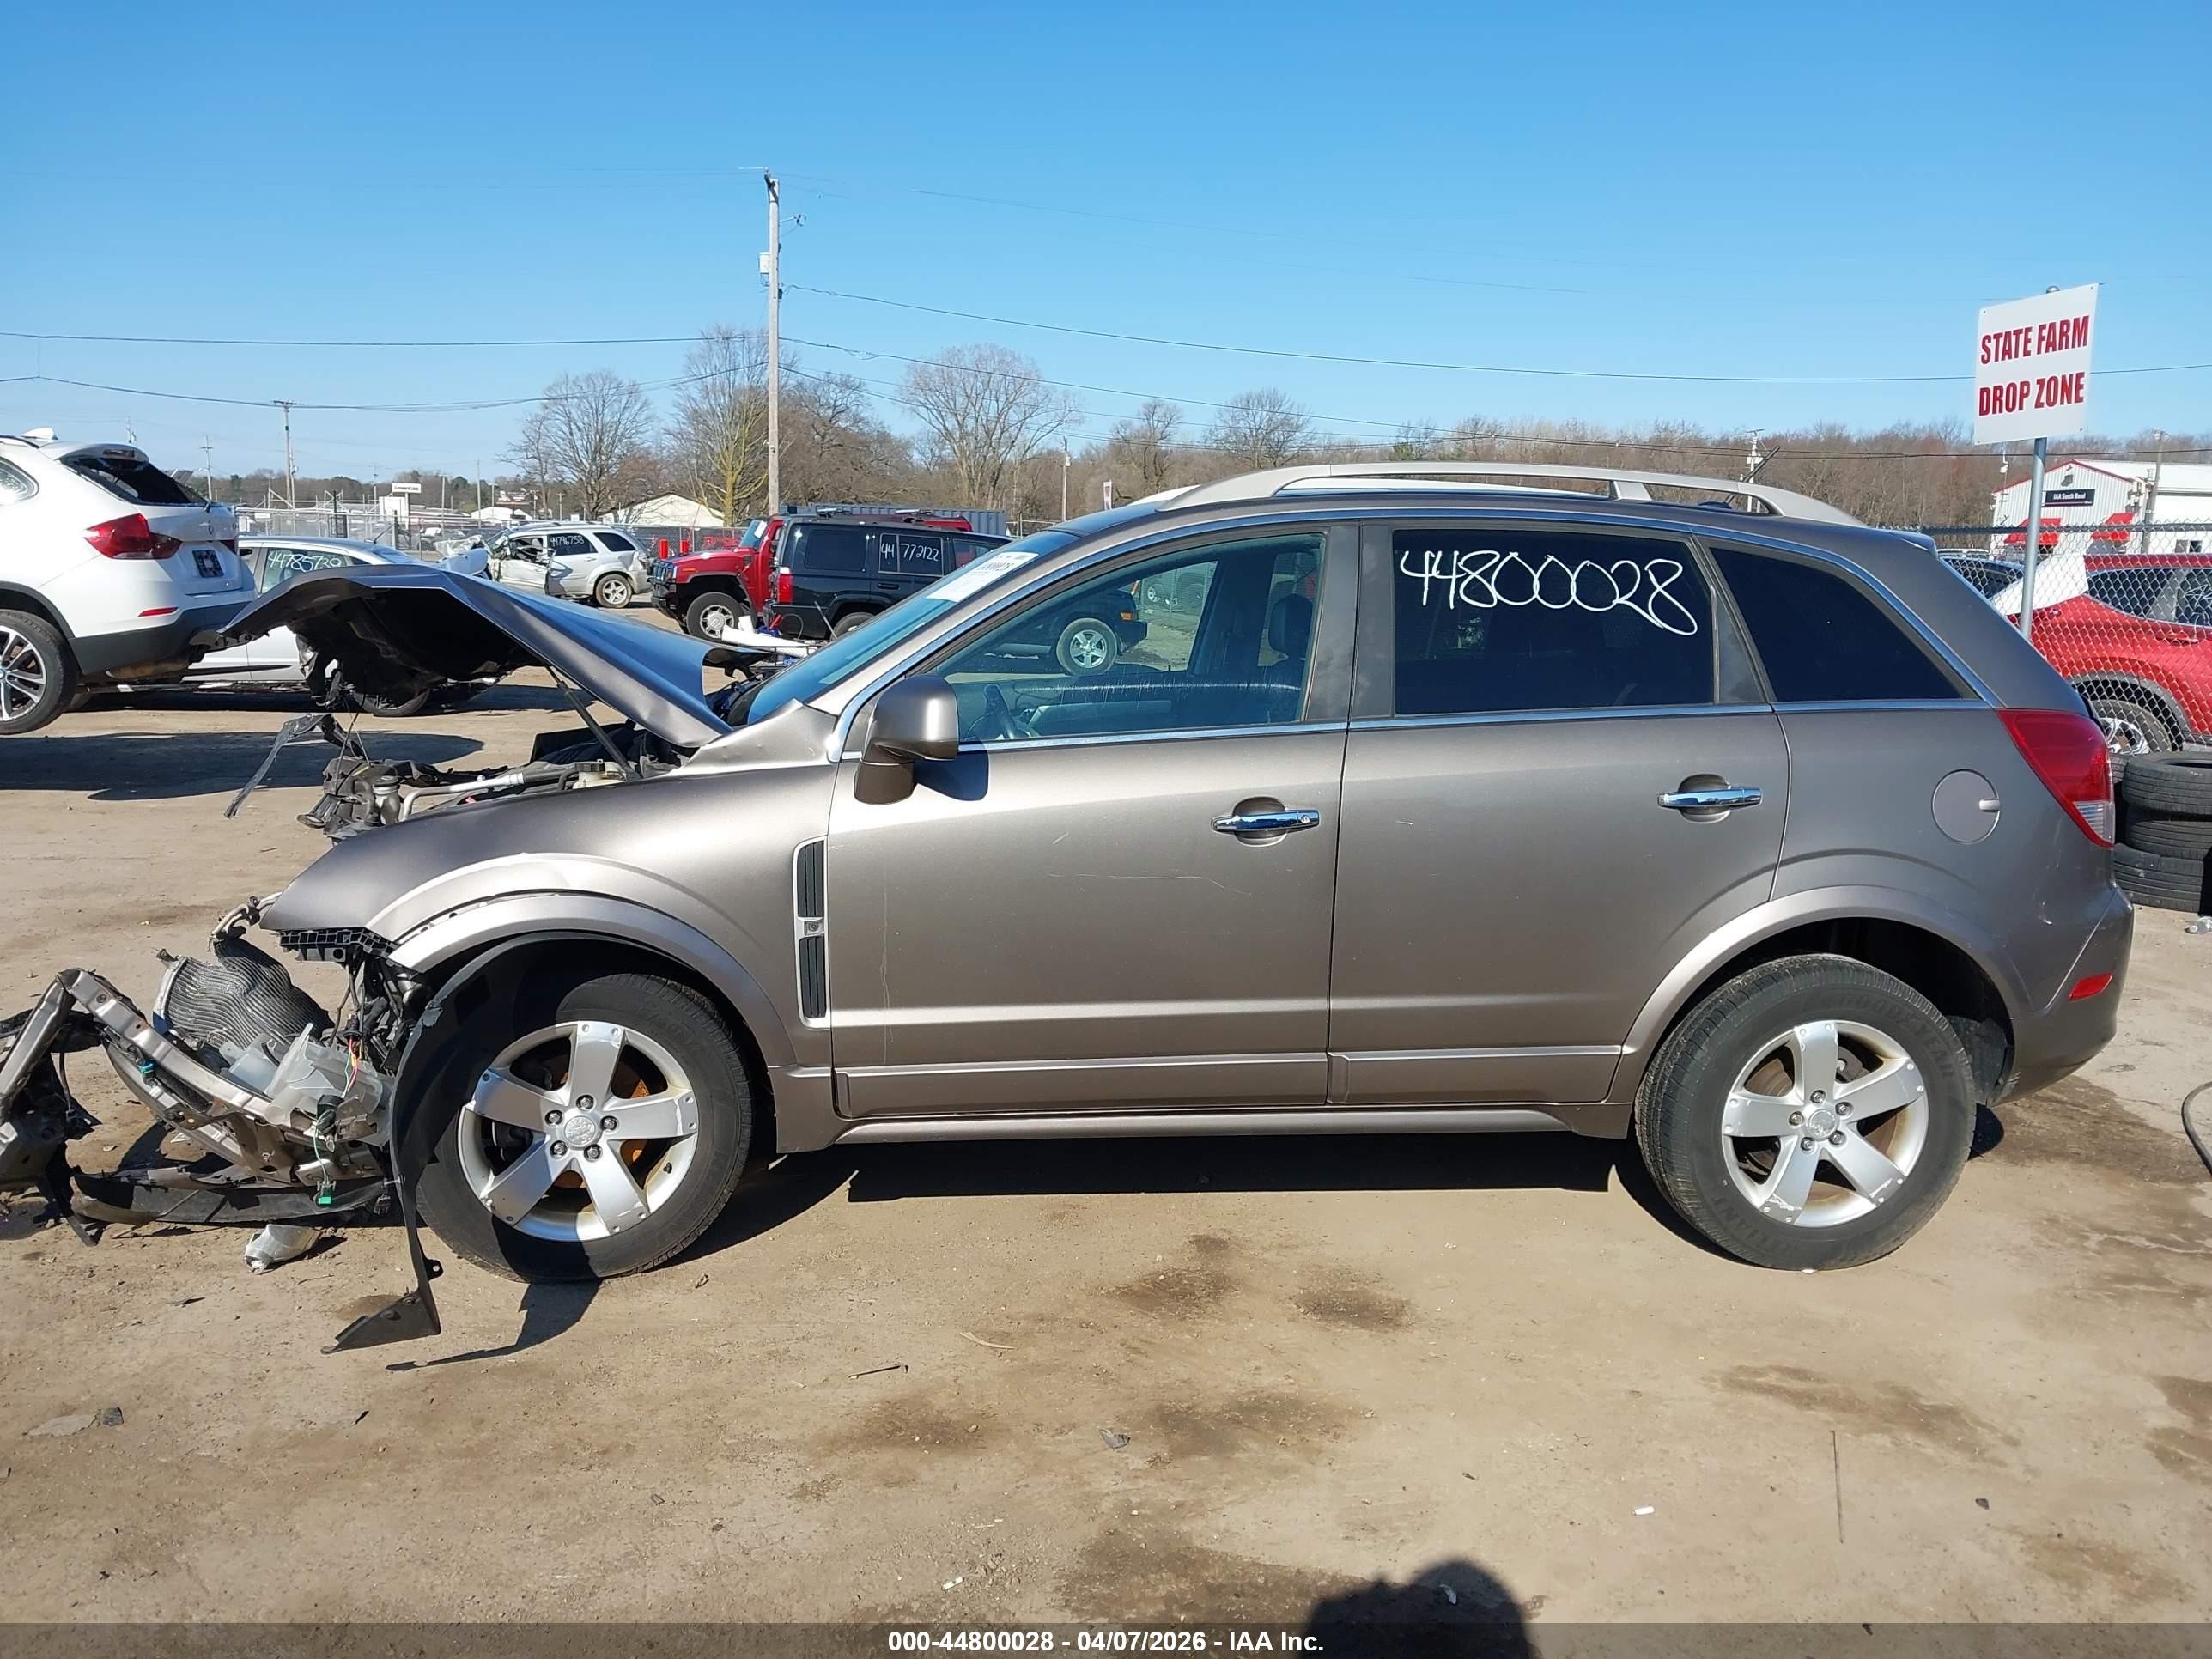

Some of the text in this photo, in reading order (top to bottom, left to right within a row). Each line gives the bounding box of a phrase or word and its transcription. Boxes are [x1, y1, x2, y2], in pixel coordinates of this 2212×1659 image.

[1980, 315, 2089, 365] STATE FARM
[1978, 372, 2085, 416] DROP ZONE
[1400, 550, 1698, 635] 44800028
